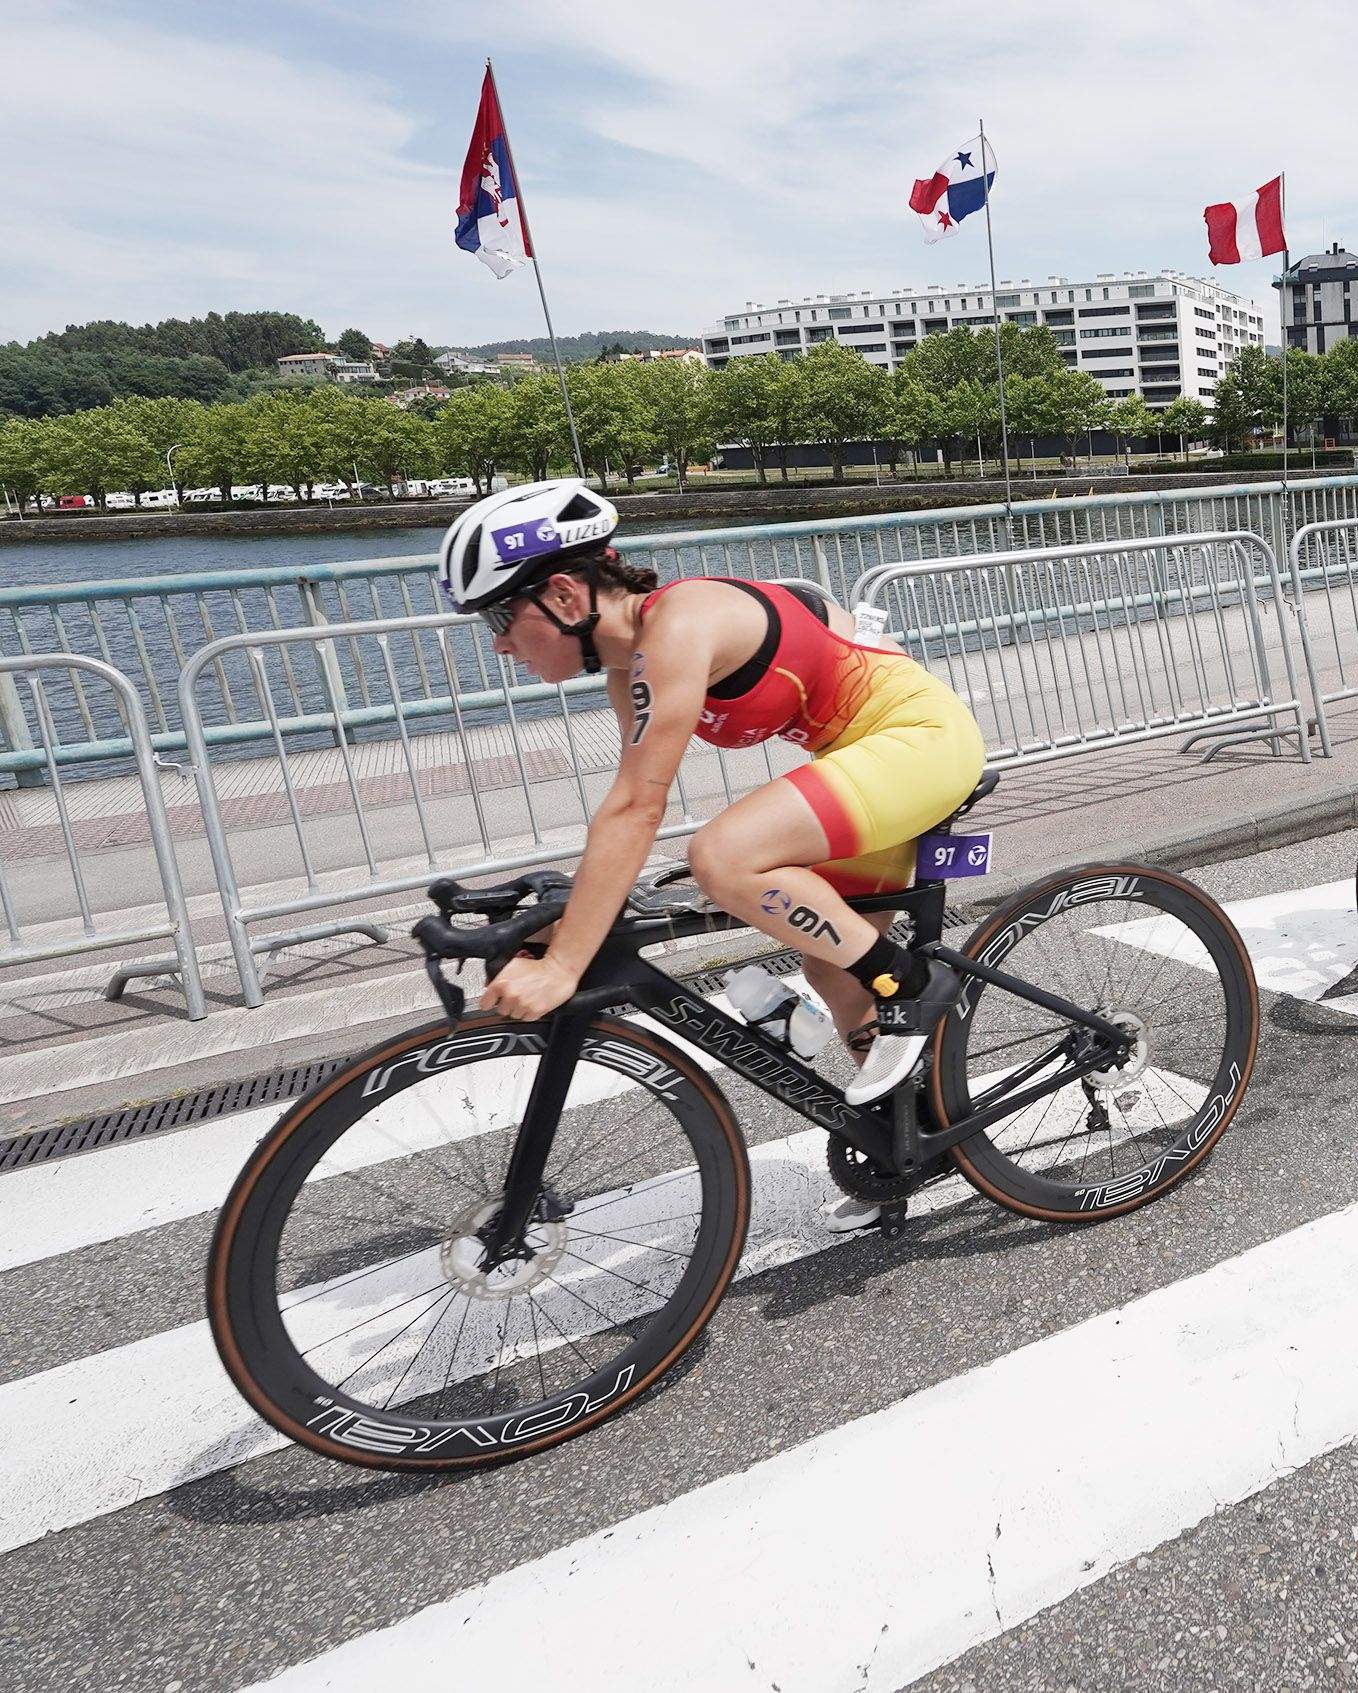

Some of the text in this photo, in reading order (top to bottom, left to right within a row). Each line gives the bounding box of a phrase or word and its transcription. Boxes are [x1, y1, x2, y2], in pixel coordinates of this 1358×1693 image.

[503, 532, 525, 550] 97
[629, 680, 653, 745] 97
[934, 846, 957, 867] 97
[787, 904, 843, 947] 97
[650, 995, 862, 1131] S-WORKS
[1079, 1060, 1242, 1211] roval
[306, 1363, 636, 1454] roval
